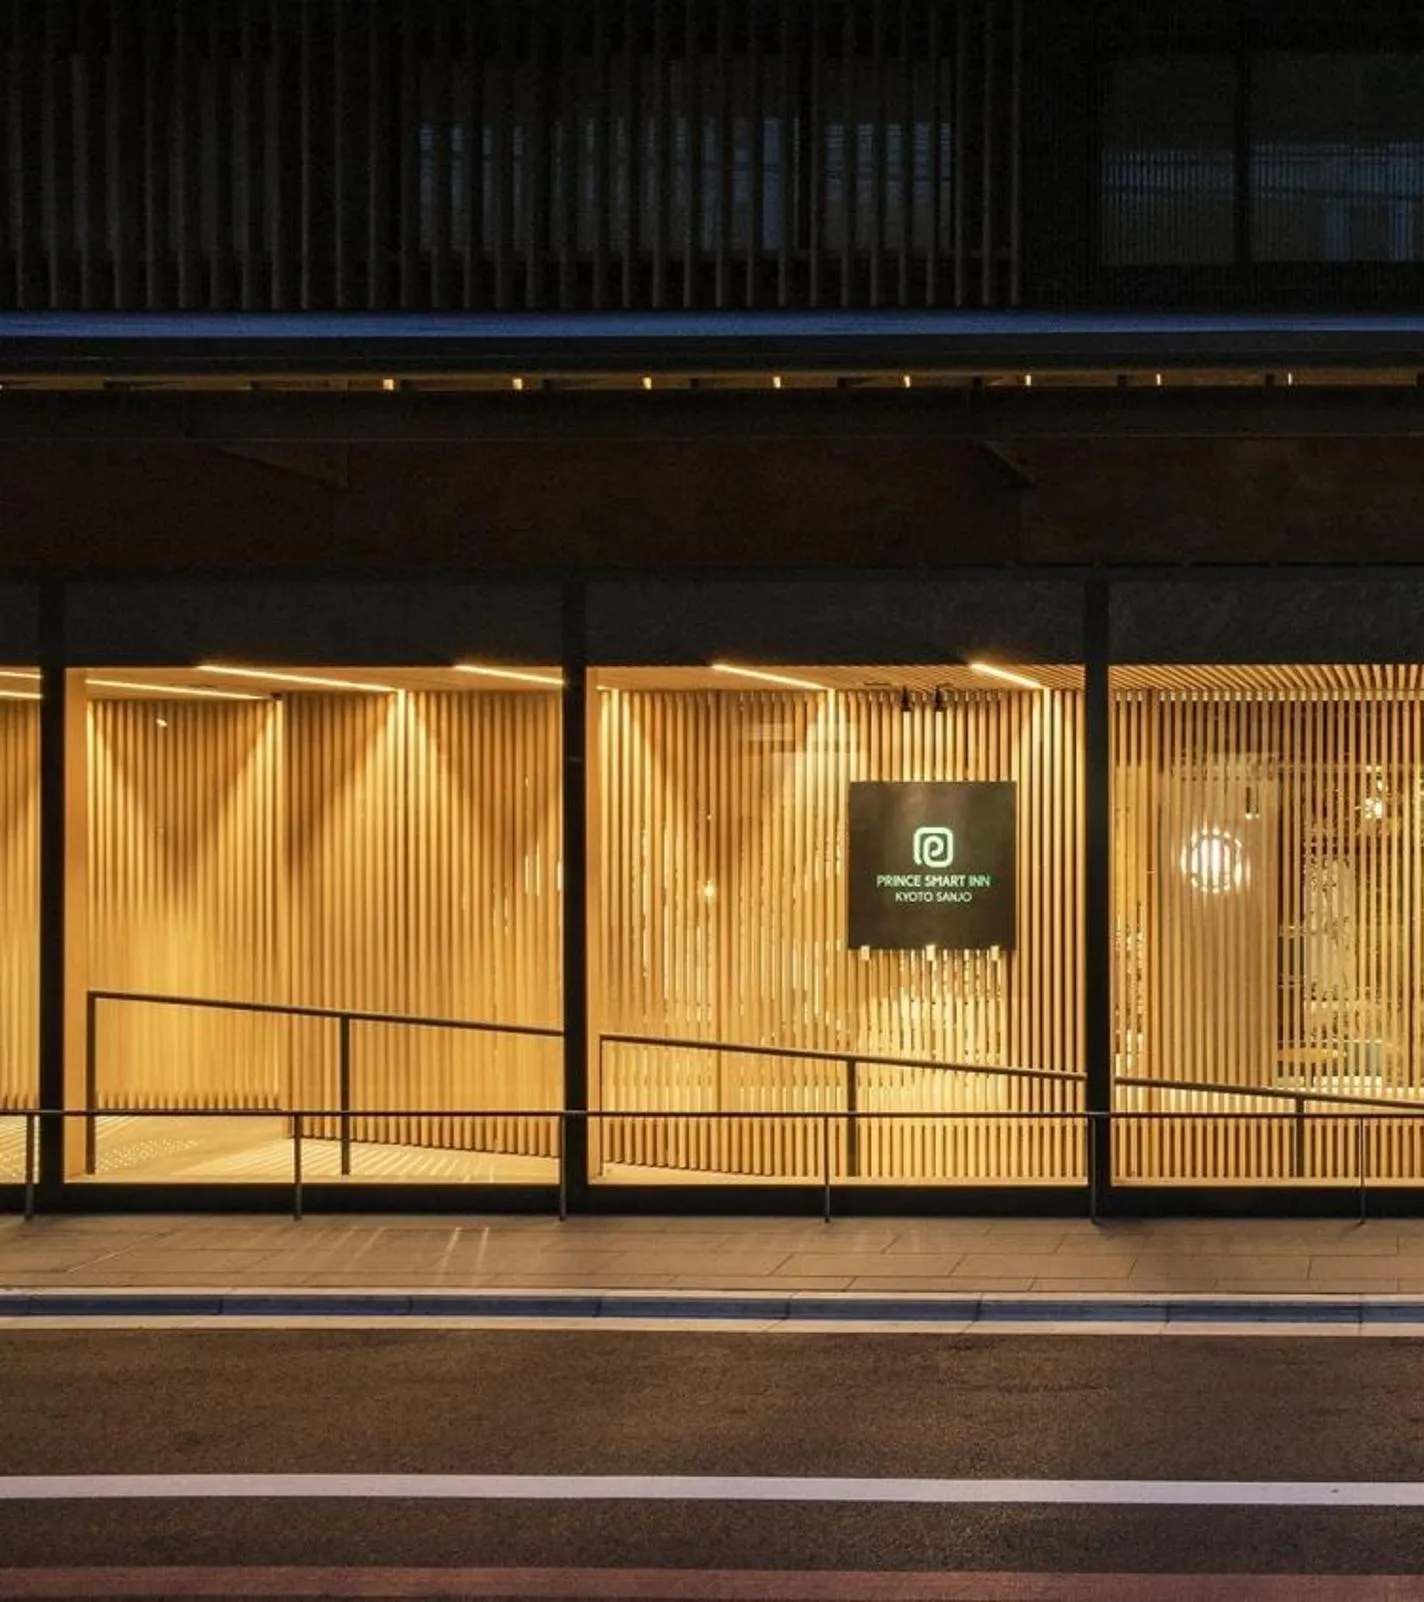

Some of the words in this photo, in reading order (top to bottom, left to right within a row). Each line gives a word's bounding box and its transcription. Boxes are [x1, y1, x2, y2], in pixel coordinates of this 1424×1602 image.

[876, 874, 921, 888] PRINCE
[924, 874, 966, 888] SMART
[967, 874, 991, 888] INN
[895, 891, 933, 902] KYOTO
[936, 891, 973, 902] SANJO
